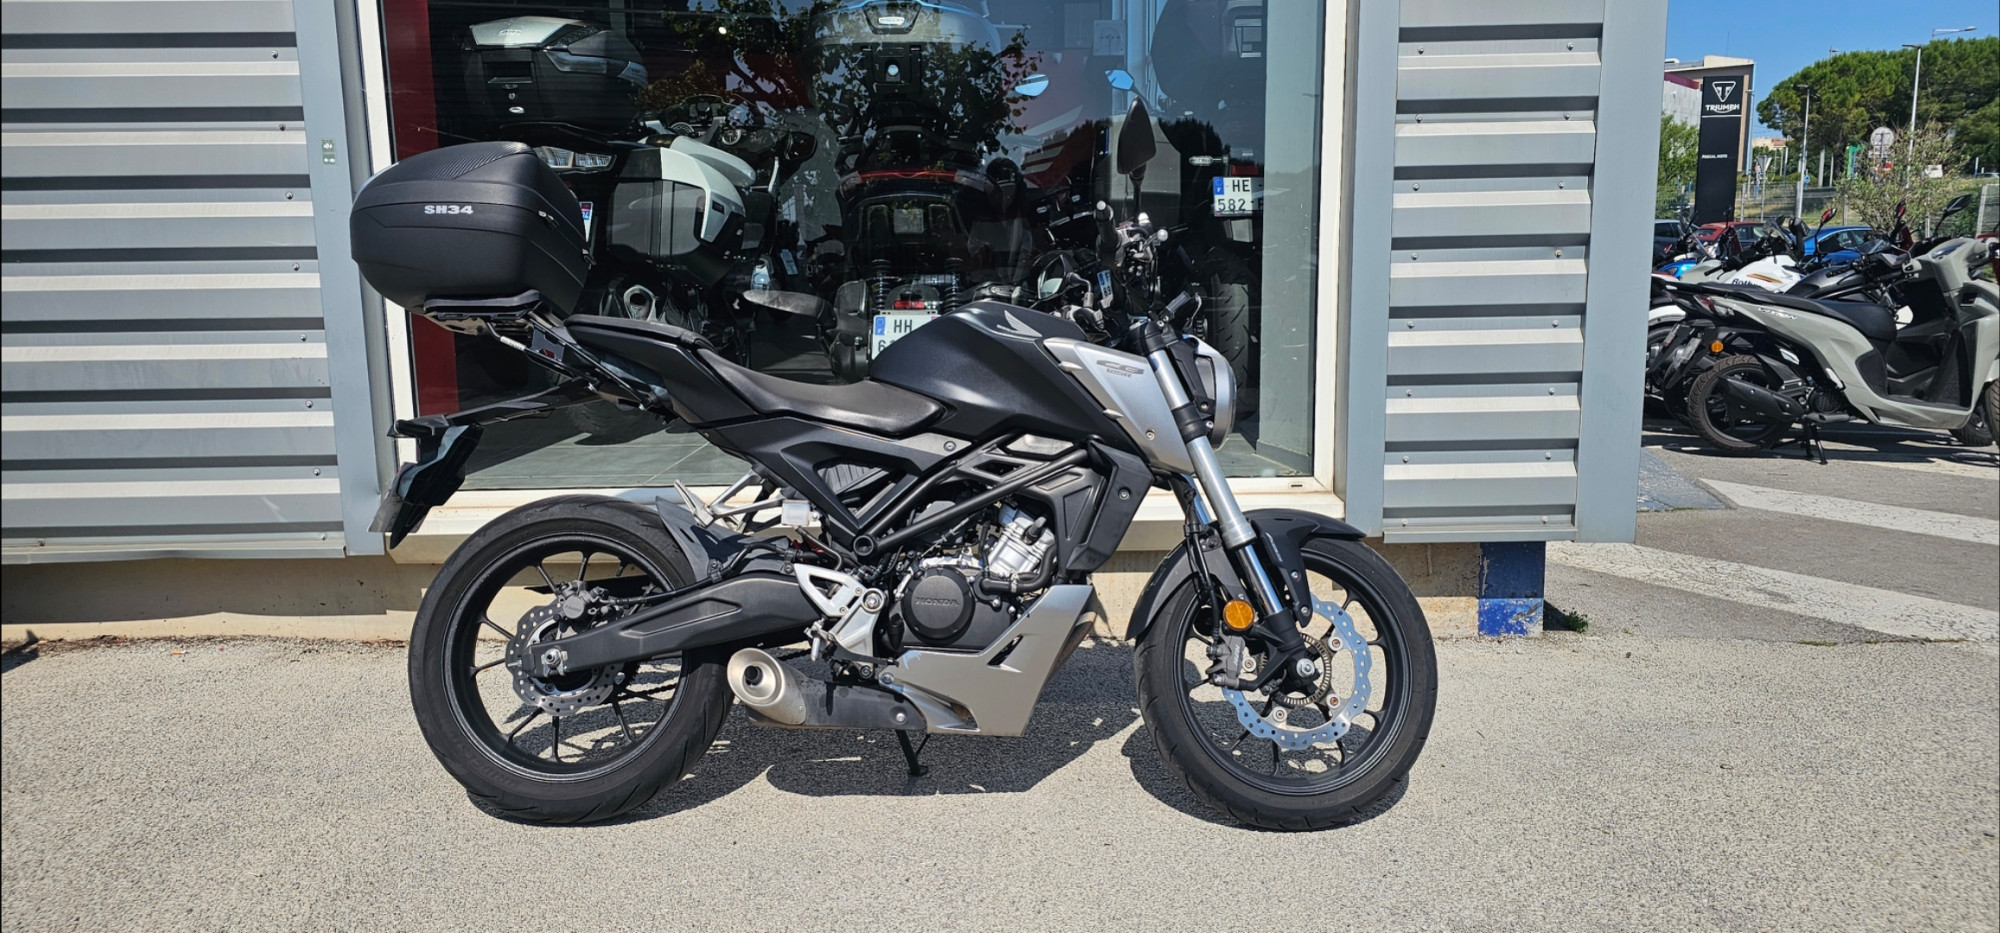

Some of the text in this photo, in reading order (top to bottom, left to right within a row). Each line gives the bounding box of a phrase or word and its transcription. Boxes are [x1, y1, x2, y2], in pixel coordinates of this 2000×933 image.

[1705, 104, 1740, 113] TRIUMPH
[1232, 179, 1251, 192] HE
[424, 204, 474, 215] SH34
[894, 319, 913, 334] HH
[915, 596, 960, 606] HONDA
